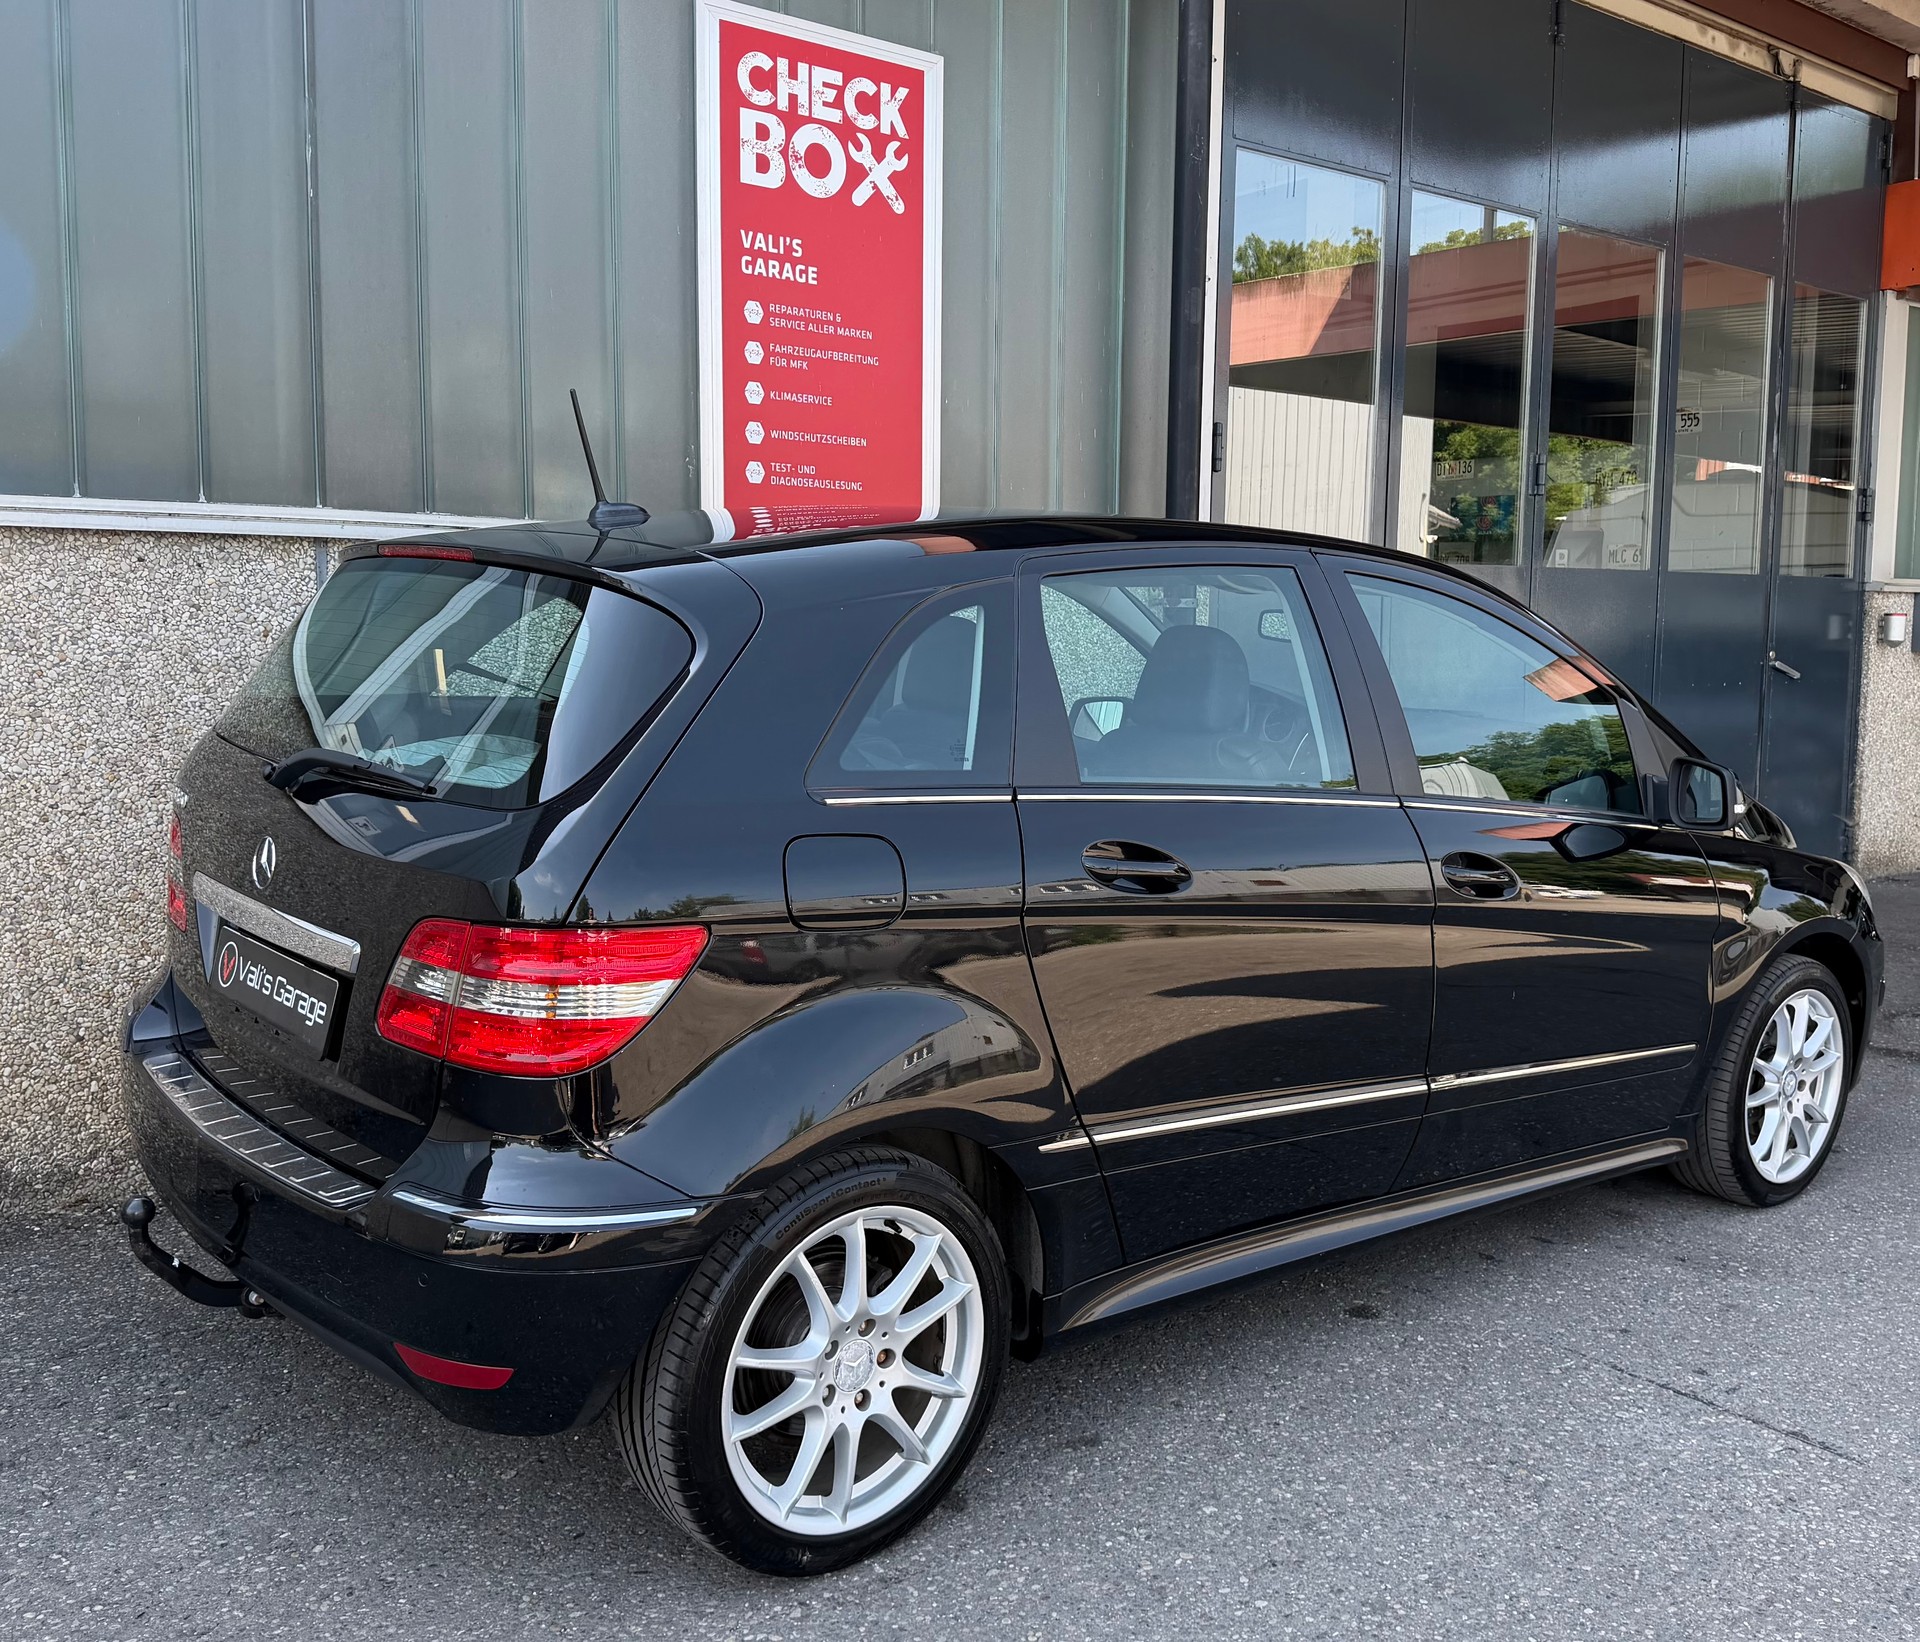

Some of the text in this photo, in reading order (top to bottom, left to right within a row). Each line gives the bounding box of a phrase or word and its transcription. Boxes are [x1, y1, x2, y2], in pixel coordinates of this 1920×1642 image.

[737, 51, 909, 139] CHECK
[740, 107, 909, 214] BOX
[740, 229, 802, 257] VALI'S
[741, 256, 818, 285] GARAGE
[769, 303, 842, 322] REPARATUREN &
[769, 317, 873, 340] SERVICE ALLER MARKEN
[769, 343, 879, 366] FAHRZEUGAUFBEREITUNG
[769, 355, 808, 370] FÜR MFK
[770, 390, 833, 406] KLIMASERVICE
[1680, 412, 1700, 428] 555
[770, 429, 867, 447] WINDSCHUTZSCHEIBEN
[770, 462, 816, 475] TEST- UND
[770, 475, 863, 491] DIAGNOSEAUSLESUNG
[240, 957, 273, 996] Vali's
[273, 977, 327, 1027] Garage
